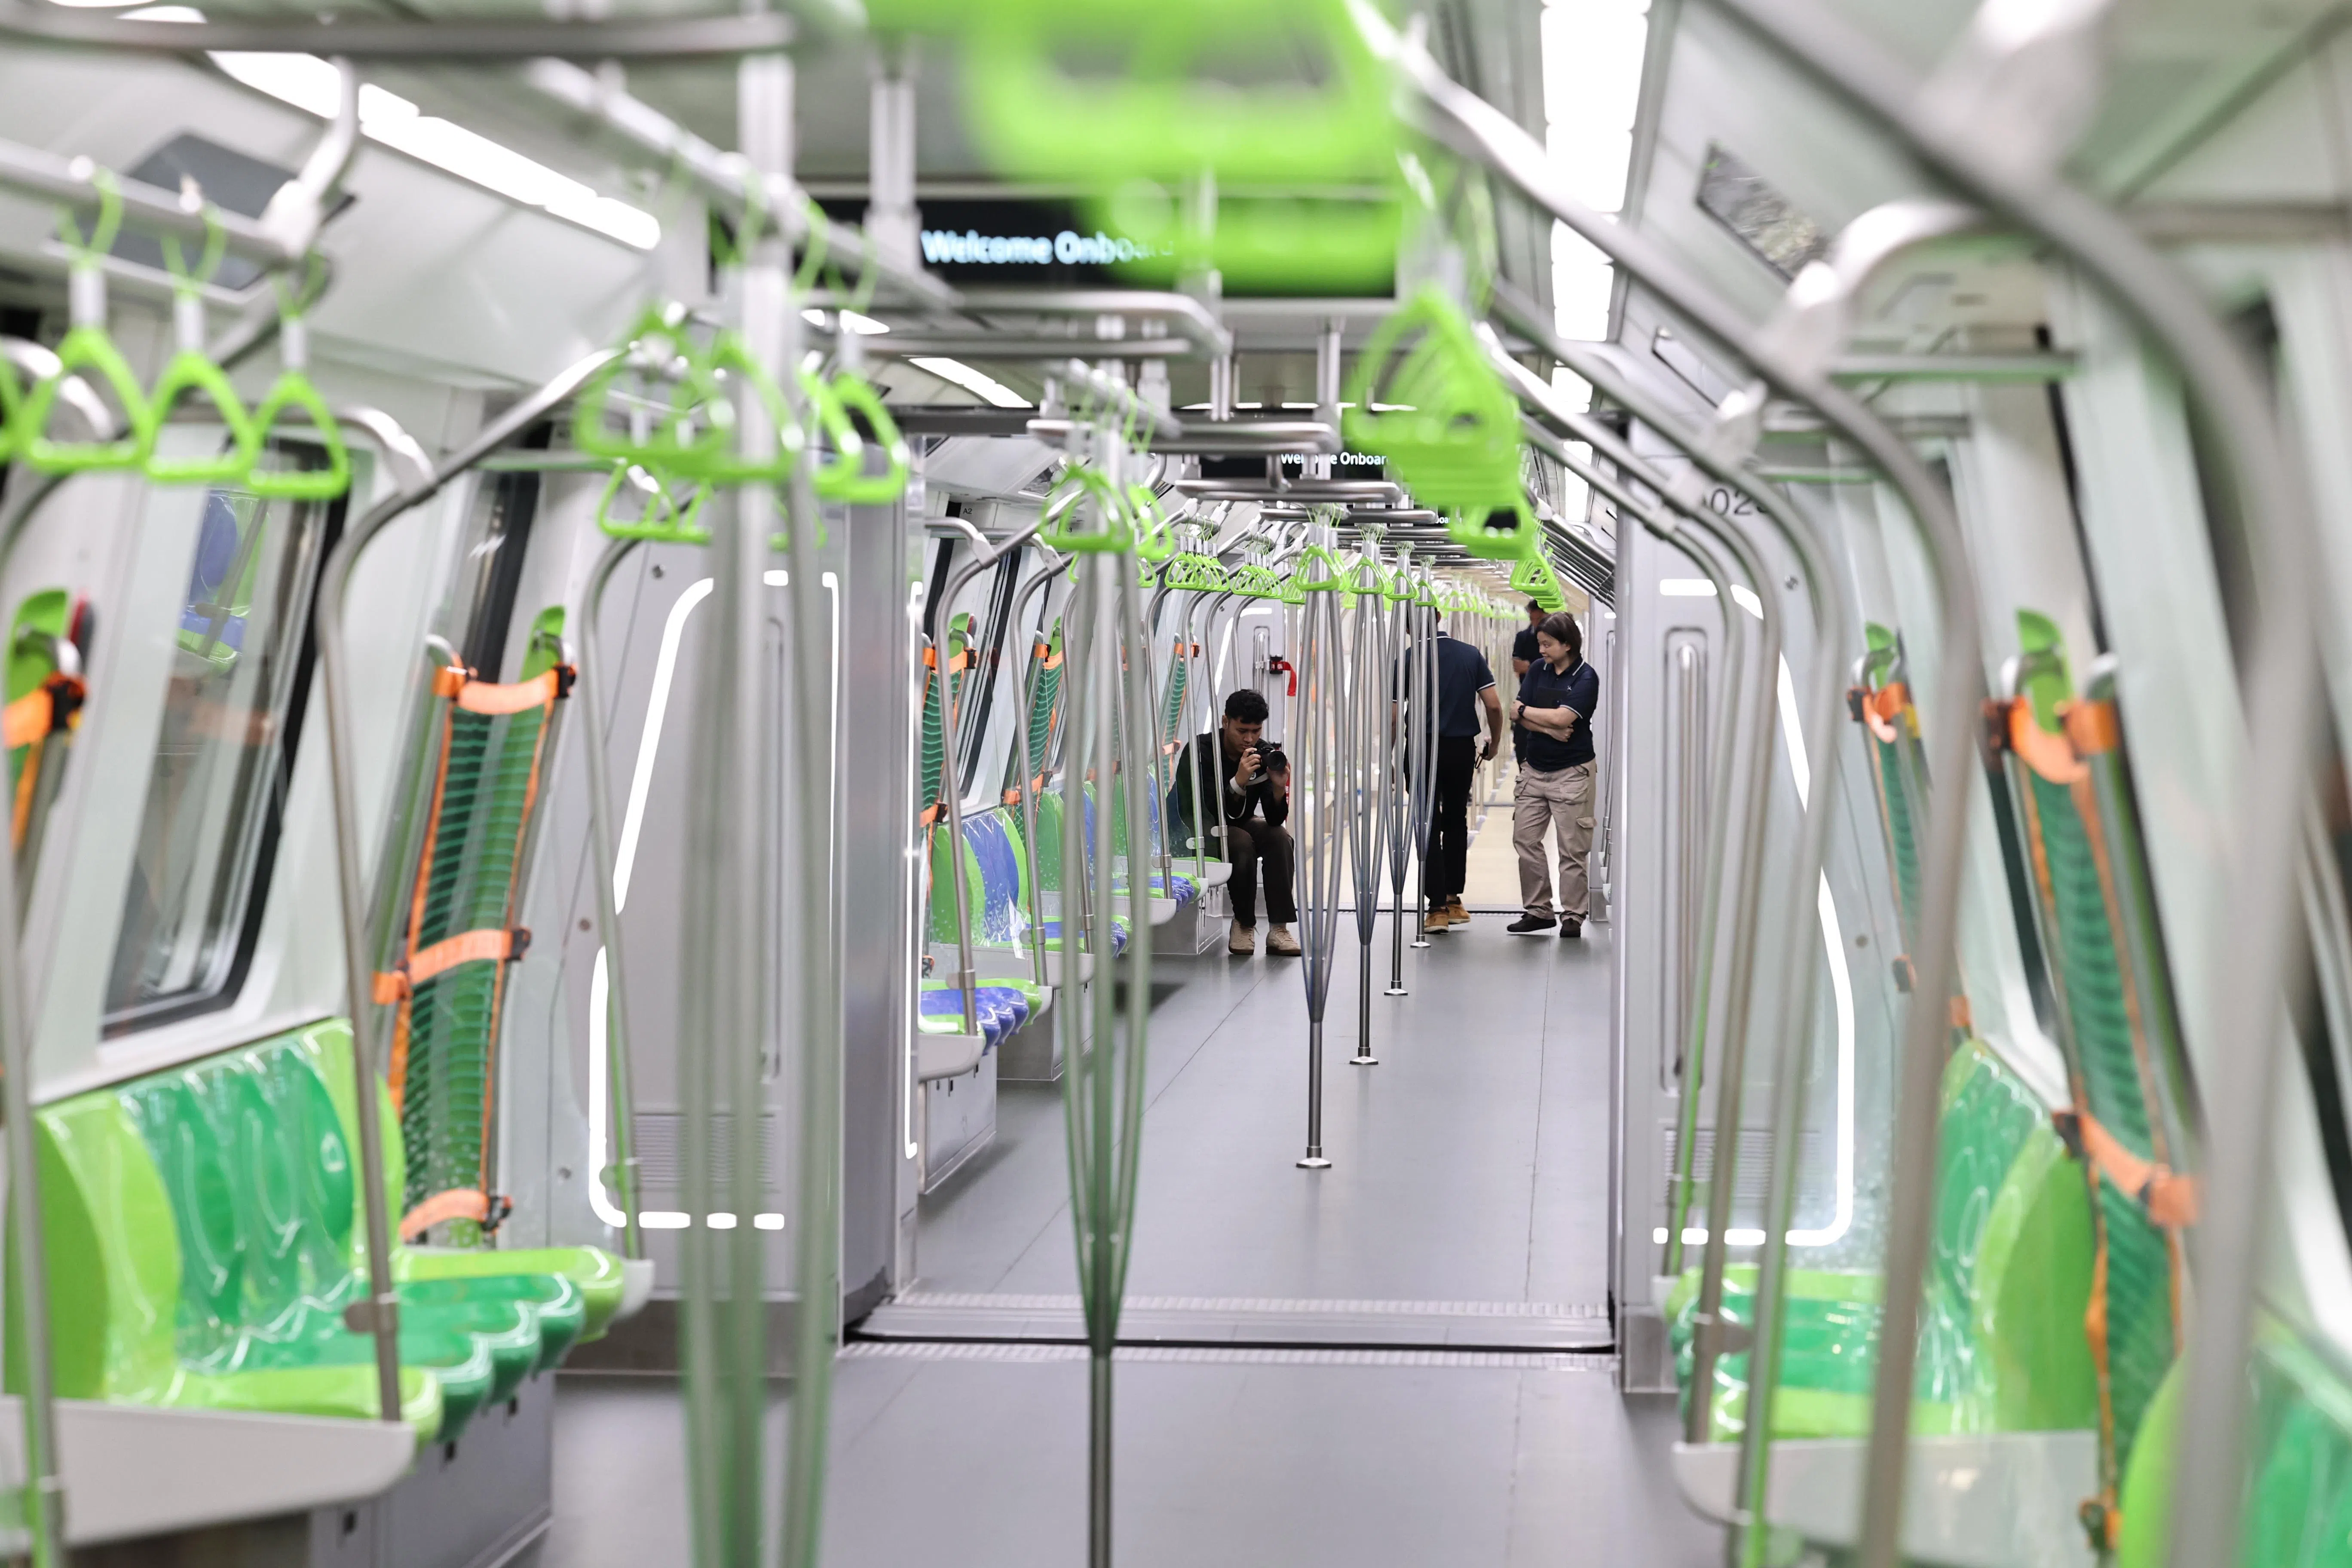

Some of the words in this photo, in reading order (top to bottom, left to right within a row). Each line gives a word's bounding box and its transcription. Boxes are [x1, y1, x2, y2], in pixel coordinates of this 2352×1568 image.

[921, 230, 1053, 264] Welcome
[1054, 230, 1174, 264] Onbo
[1281, 453, 1338, 465] Wele
[1340, 451, 1388, 465] Onboar
